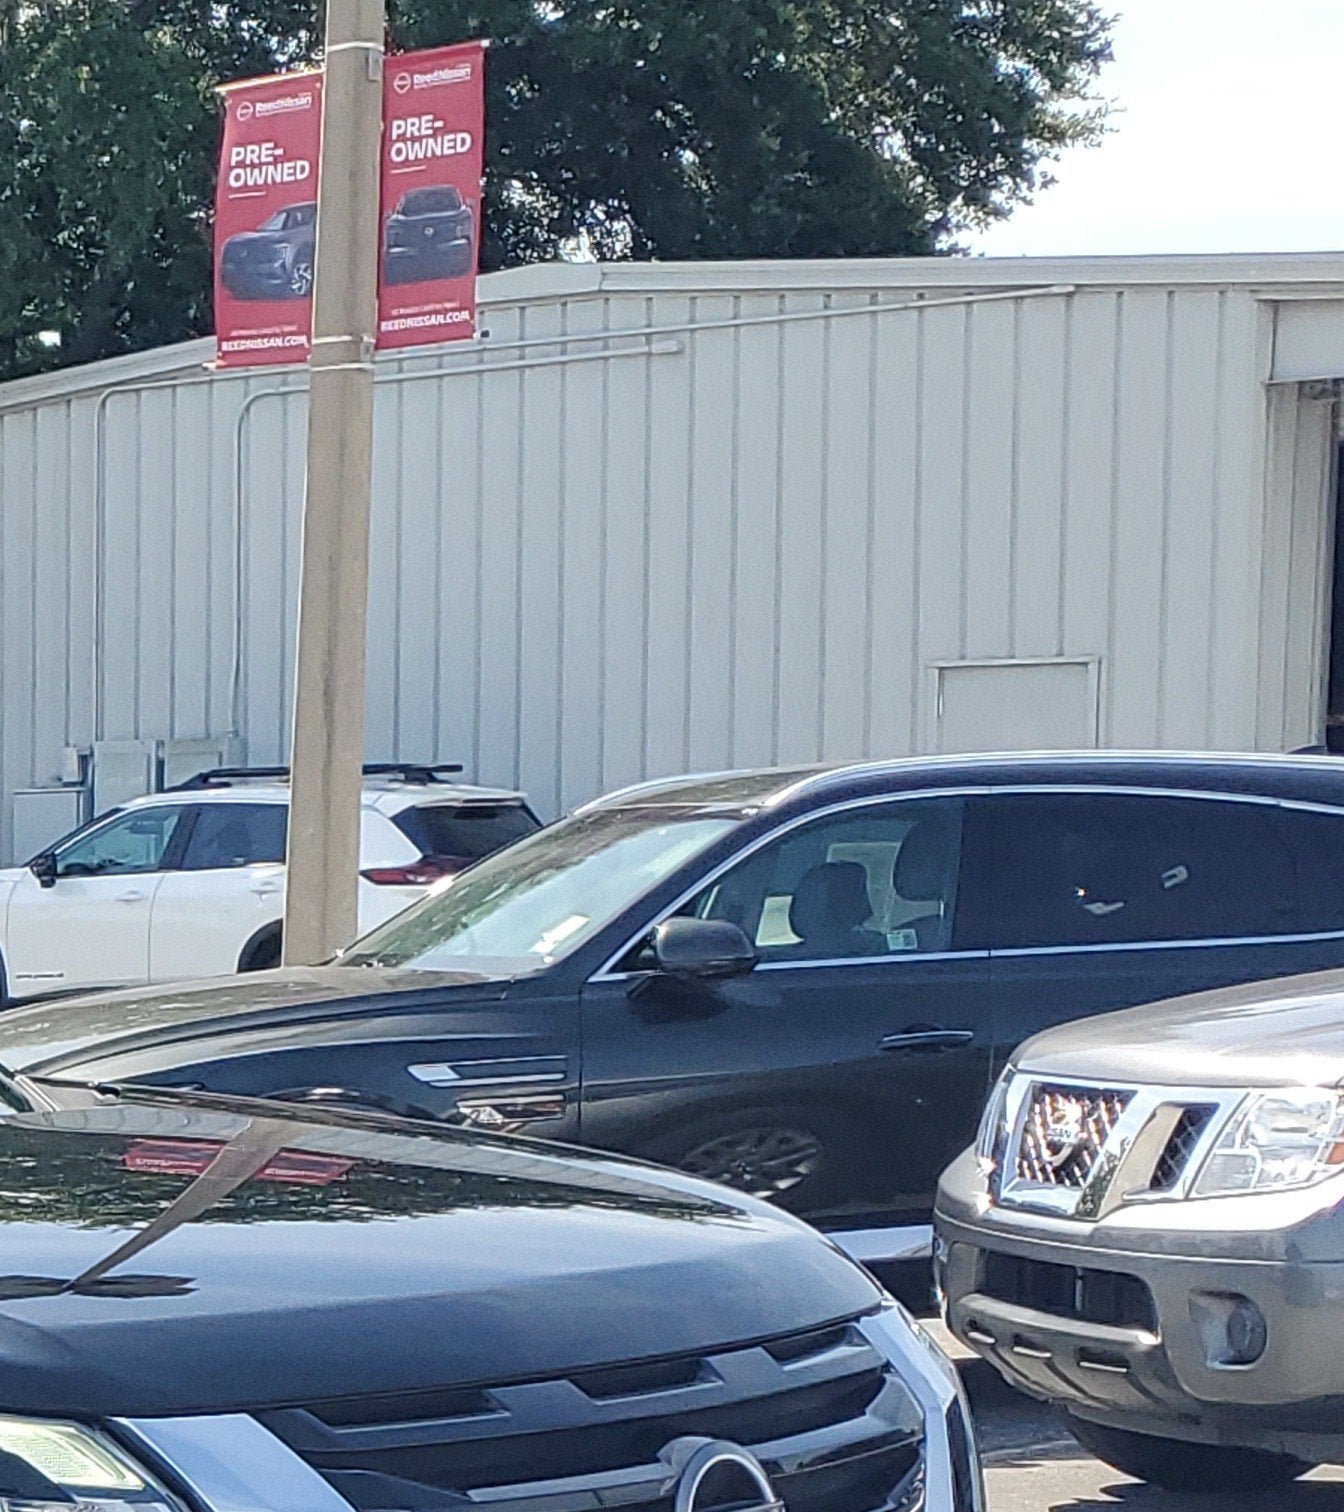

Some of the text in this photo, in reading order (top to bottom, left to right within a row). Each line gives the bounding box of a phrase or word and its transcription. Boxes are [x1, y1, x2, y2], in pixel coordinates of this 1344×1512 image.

[391, 114, 444, 141] PRE-
[230, 142, 284, 167] PRE-
[390, 132, 472, 163] OWNED
[228, 160, 310, 188] OWNED
